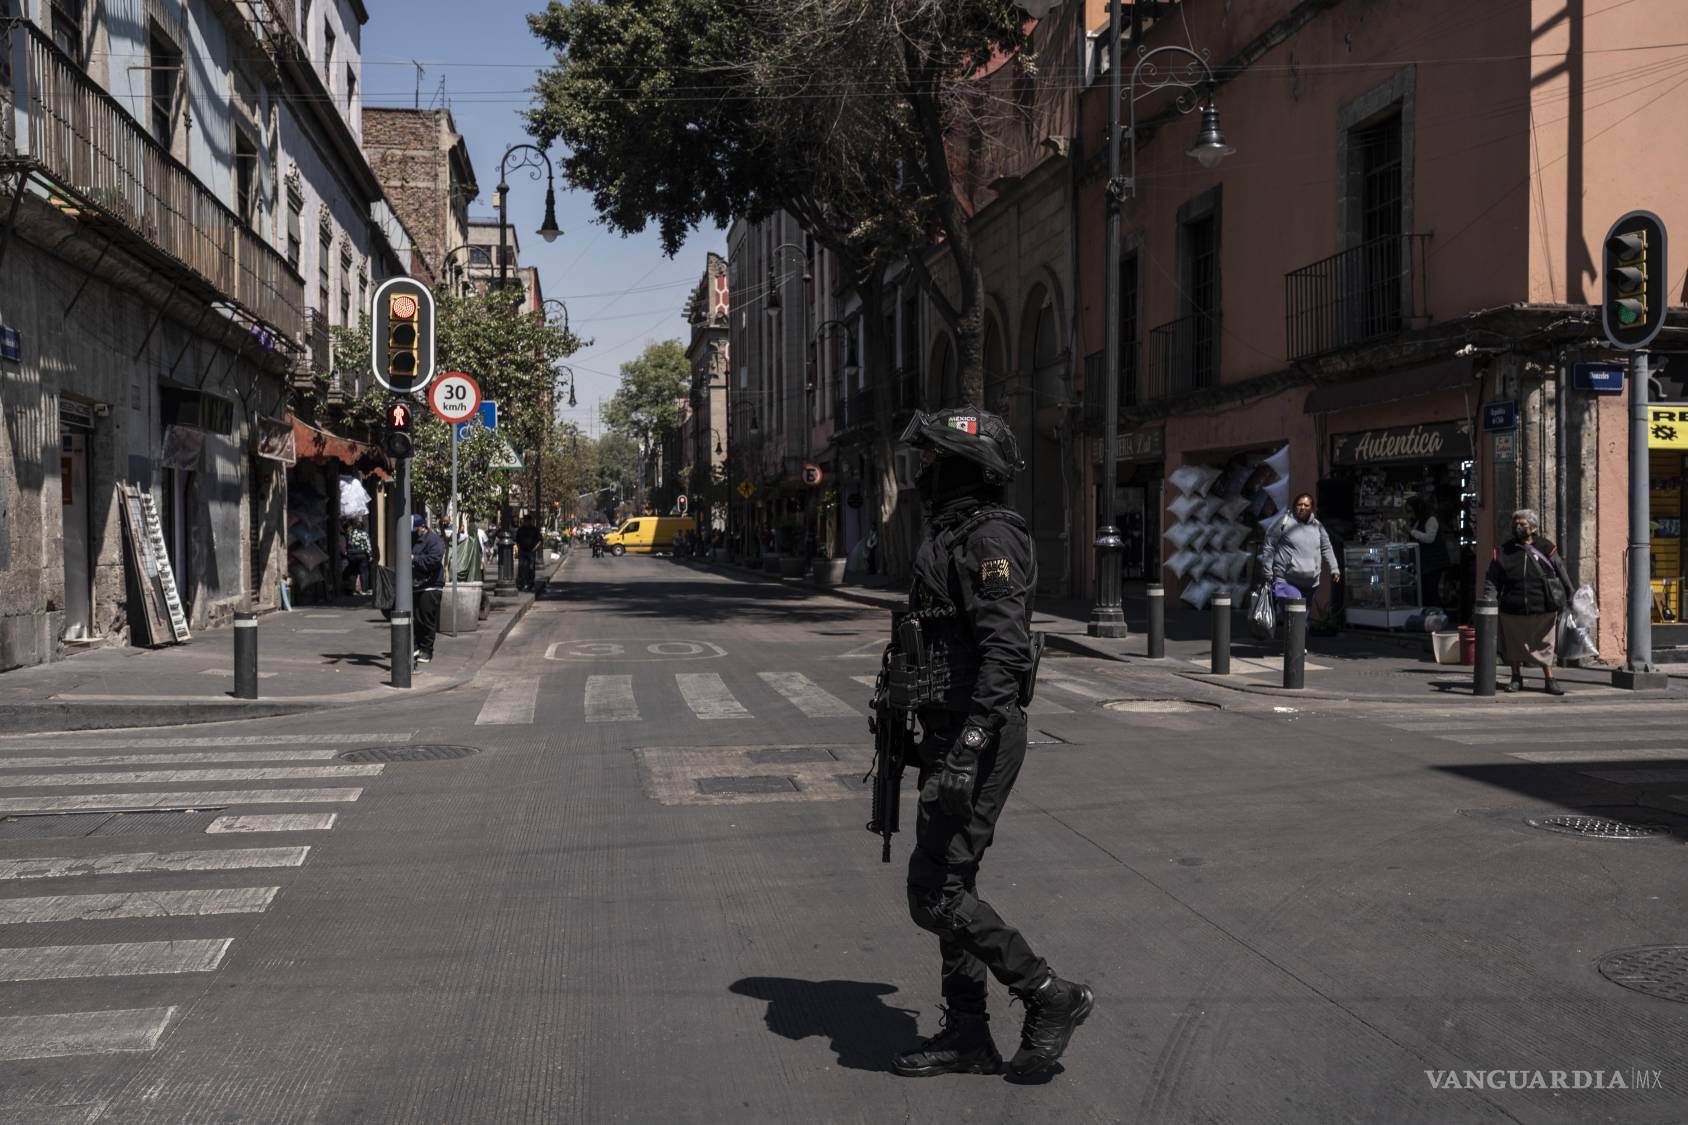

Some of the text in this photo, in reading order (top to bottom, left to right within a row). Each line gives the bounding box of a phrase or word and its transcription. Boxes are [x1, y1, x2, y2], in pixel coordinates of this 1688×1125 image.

[444, 385, 466, 400] 30
[443, 402, 466, 411] km/h
[1355, 425, 1443, 461] Autentica
[569, 642, 703, 656] 30
